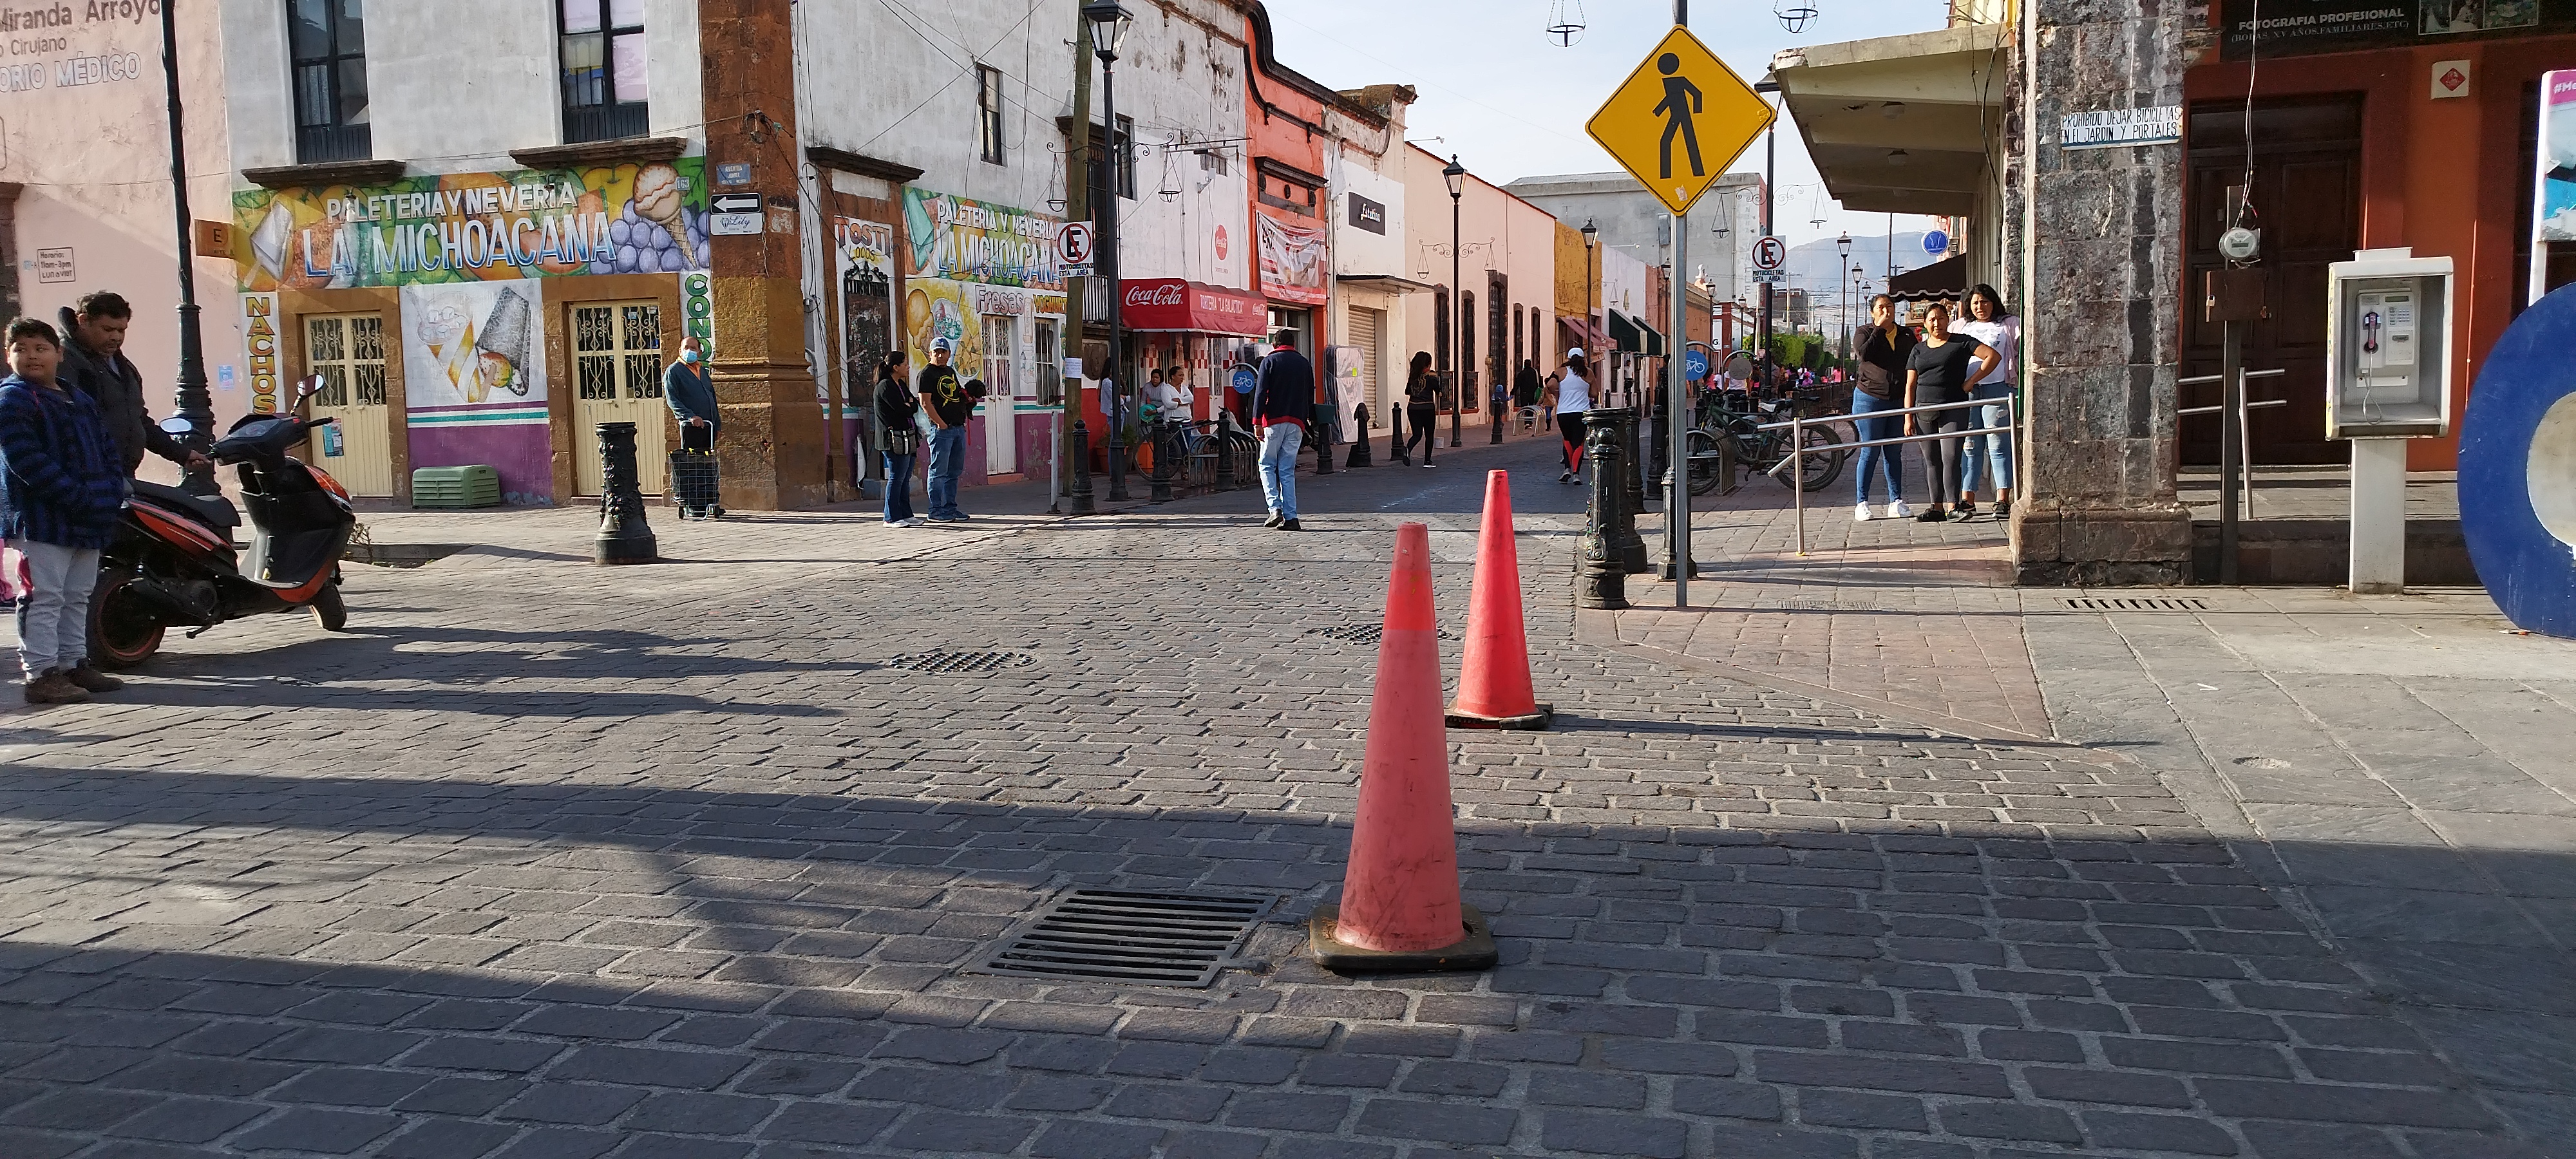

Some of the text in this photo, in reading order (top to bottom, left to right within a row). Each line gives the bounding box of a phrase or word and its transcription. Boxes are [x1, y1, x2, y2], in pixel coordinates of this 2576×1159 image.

[86, 0, 160, 24] Arroyo
[2239, 8, 2404, 31] FOTOGRAFIA PROFESIONAL
[11, 37, 66, 56] Cirujano
[54, 51, 142, 88] MÉDICO
[2062, 112, 2102, 127] PROHIBIDO
[2107, 109, 2132, 125] DEJAR
[2072, 129, 2079, 142] EL
[2084, 126, 2114, 142] JARDIN
[2121, 126, 2127, 140] Y
[2133, 122, 2177, 140] PORTALES
[677, 180, 689, 189] 163
[327, 182, 578, 224] PALETERIA Y NEVERIA
[937, 200, 1057, 241] PALETERIA Y NEVERIA
[214, 228, 222, 243] E
[303, 211, 616, 278] LA MICHOACANA
[834, 217, 891, 259] TOSTI
[936, 229, 1063, 285] LA MICHOACANA
[975, 285, 1025, 315] Fresas
[1125, 284, 1186, 306] Coca-Cola
[246, 297, 276, 415] NACHOS
